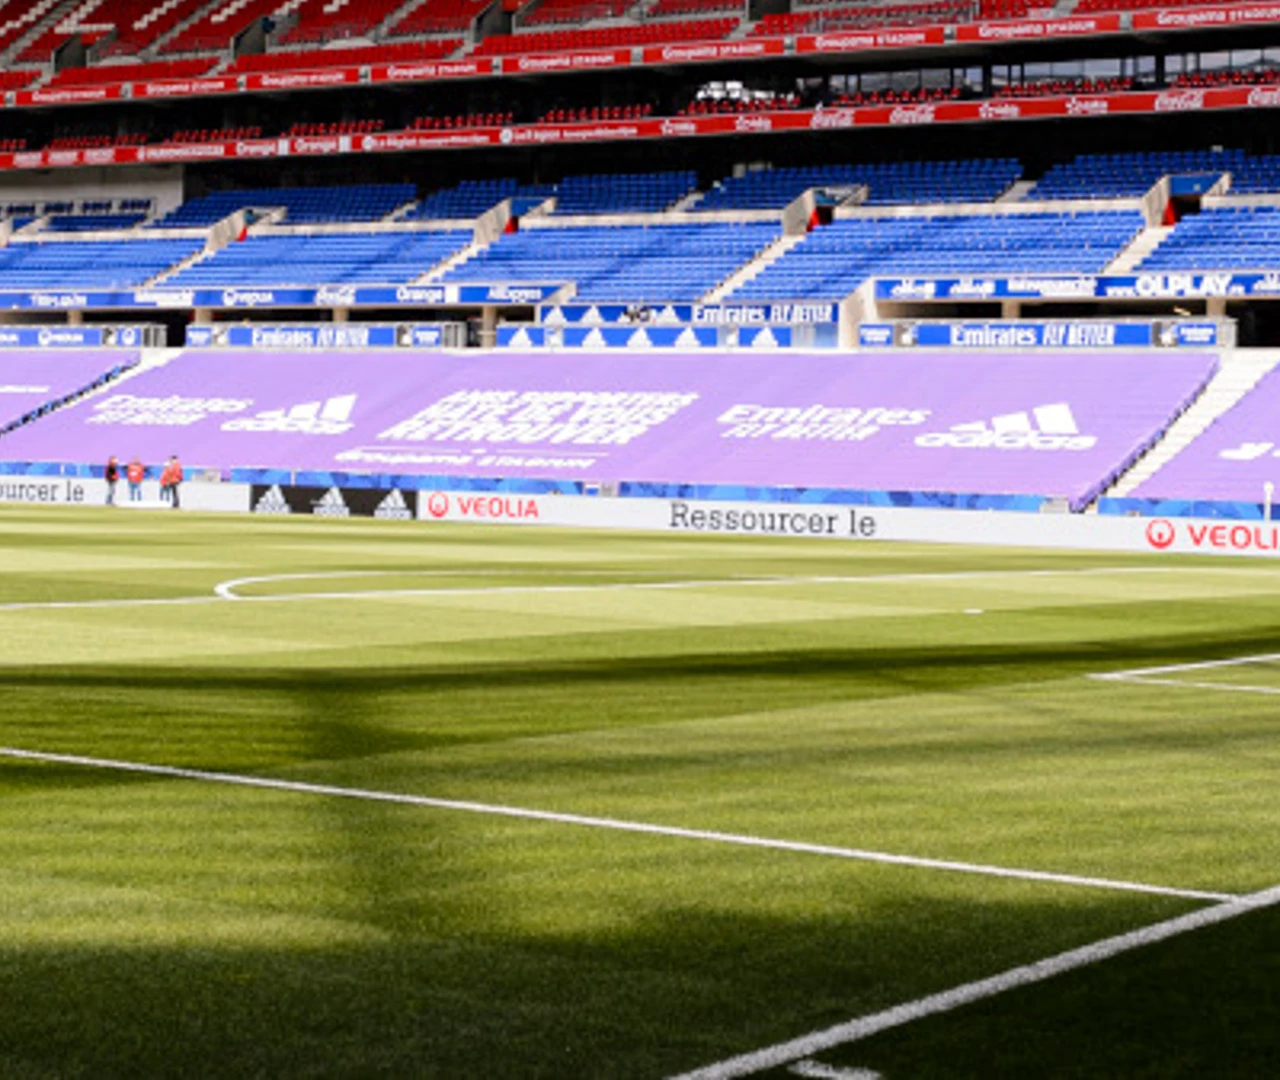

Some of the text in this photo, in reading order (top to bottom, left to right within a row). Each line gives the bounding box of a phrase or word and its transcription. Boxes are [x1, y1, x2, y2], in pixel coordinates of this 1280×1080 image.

[692, 304, 765, 322] Emirates
[949, 324, 1037, 346] Emirates
[716, 404, 932, 425] Emirates
[913, 431, 1099, 451] adidas
[66, 481, 84, 502] le
[457, 497, 540, 519] VEOLIA
[669, 501, 876, 536] Ressourcer le
